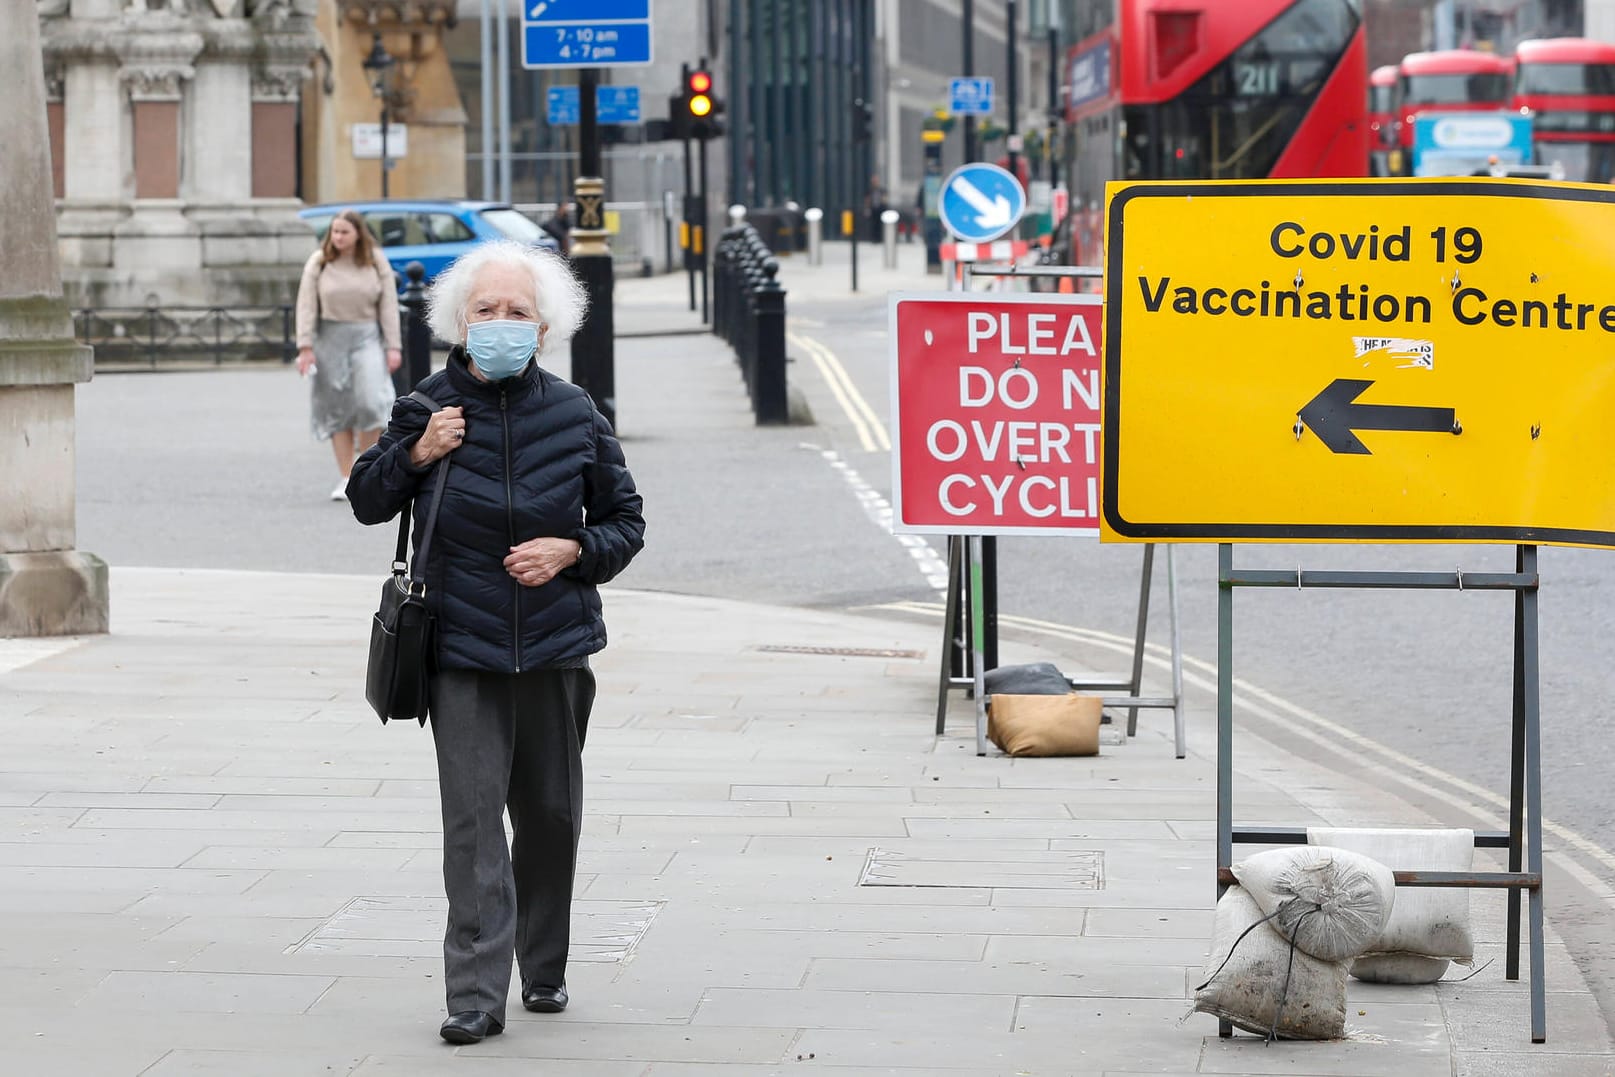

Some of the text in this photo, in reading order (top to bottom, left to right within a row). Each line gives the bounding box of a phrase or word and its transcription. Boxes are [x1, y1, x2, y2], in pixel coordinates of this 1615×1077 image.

[592, 46, 616, 60] pm
[595, 30, 619, 42] am
[1241, 64, 1278, 94] 211
[1270, 221, 1483, 264] Covid 19
[1138, 276, 1615, 333] Vaccination Centre
[959, 366, 1039, 409] DO
